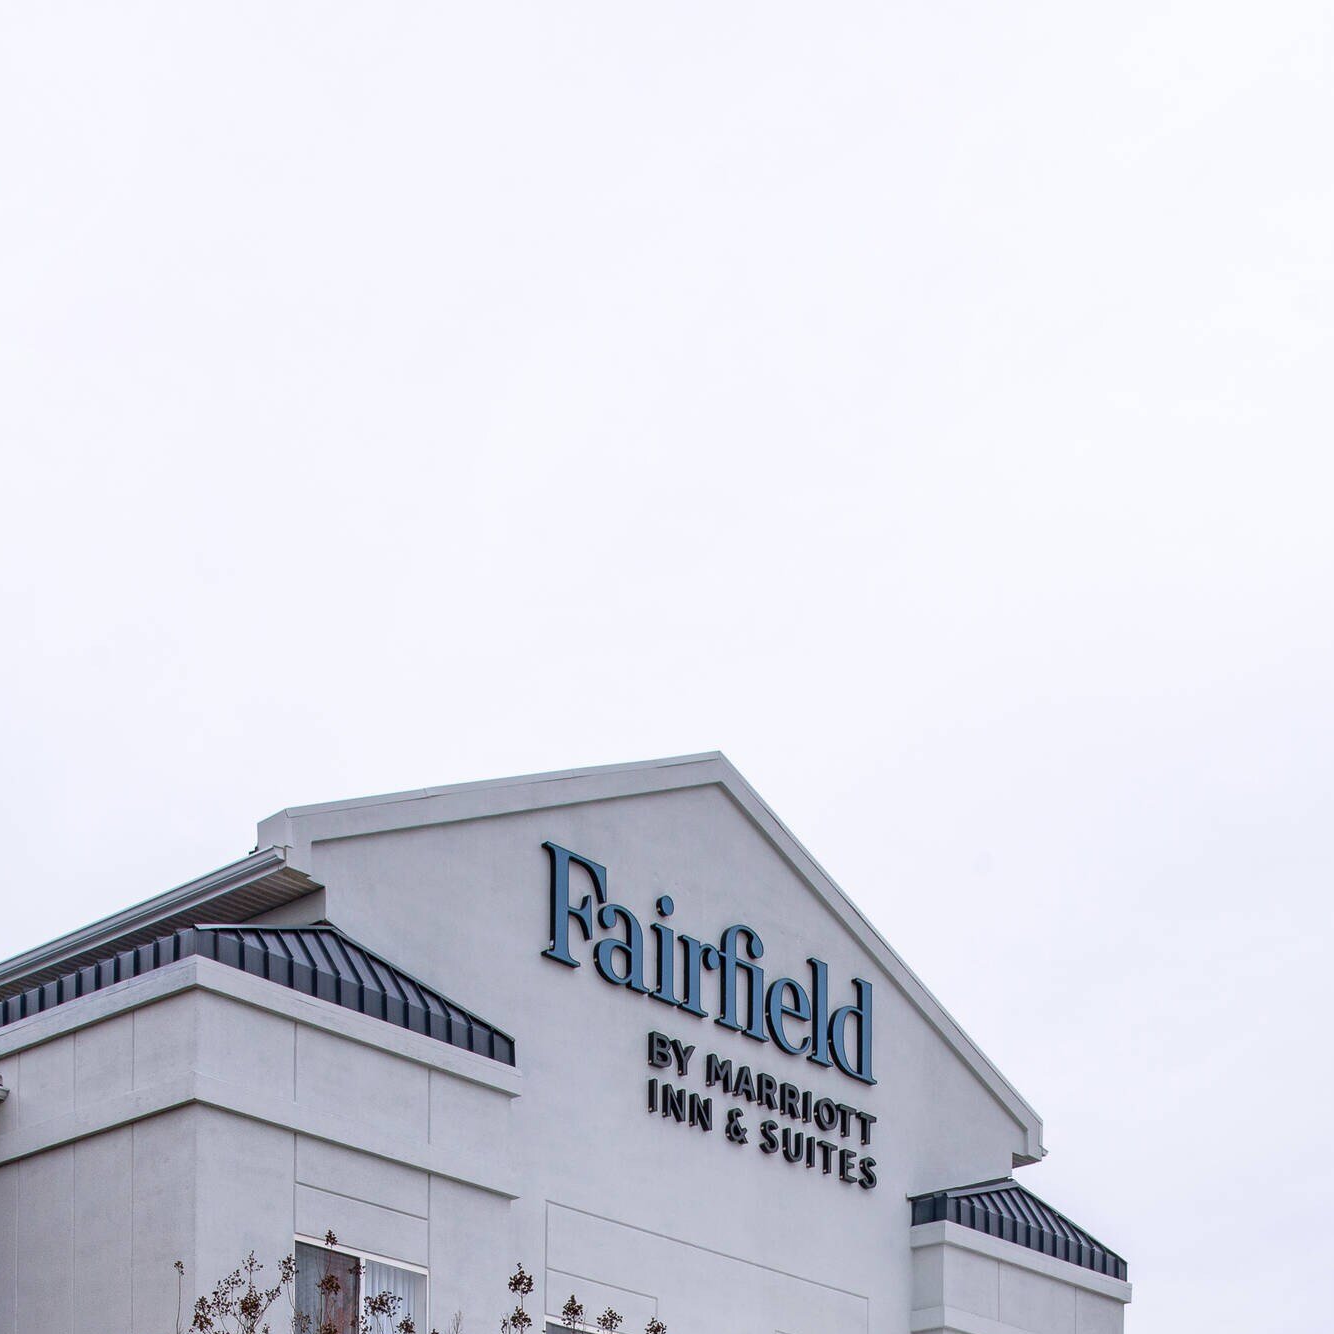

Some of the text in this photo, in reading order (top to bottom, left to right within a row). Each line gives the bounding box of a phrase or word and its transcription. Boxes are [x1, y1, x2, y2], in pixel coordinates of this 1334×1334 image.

[541, 841, 877, 1085] Fairfield
[648, 1031, 877, 1145] BY MARRIOTT
[648, 1078, 877, 1190] INN & SUITES
